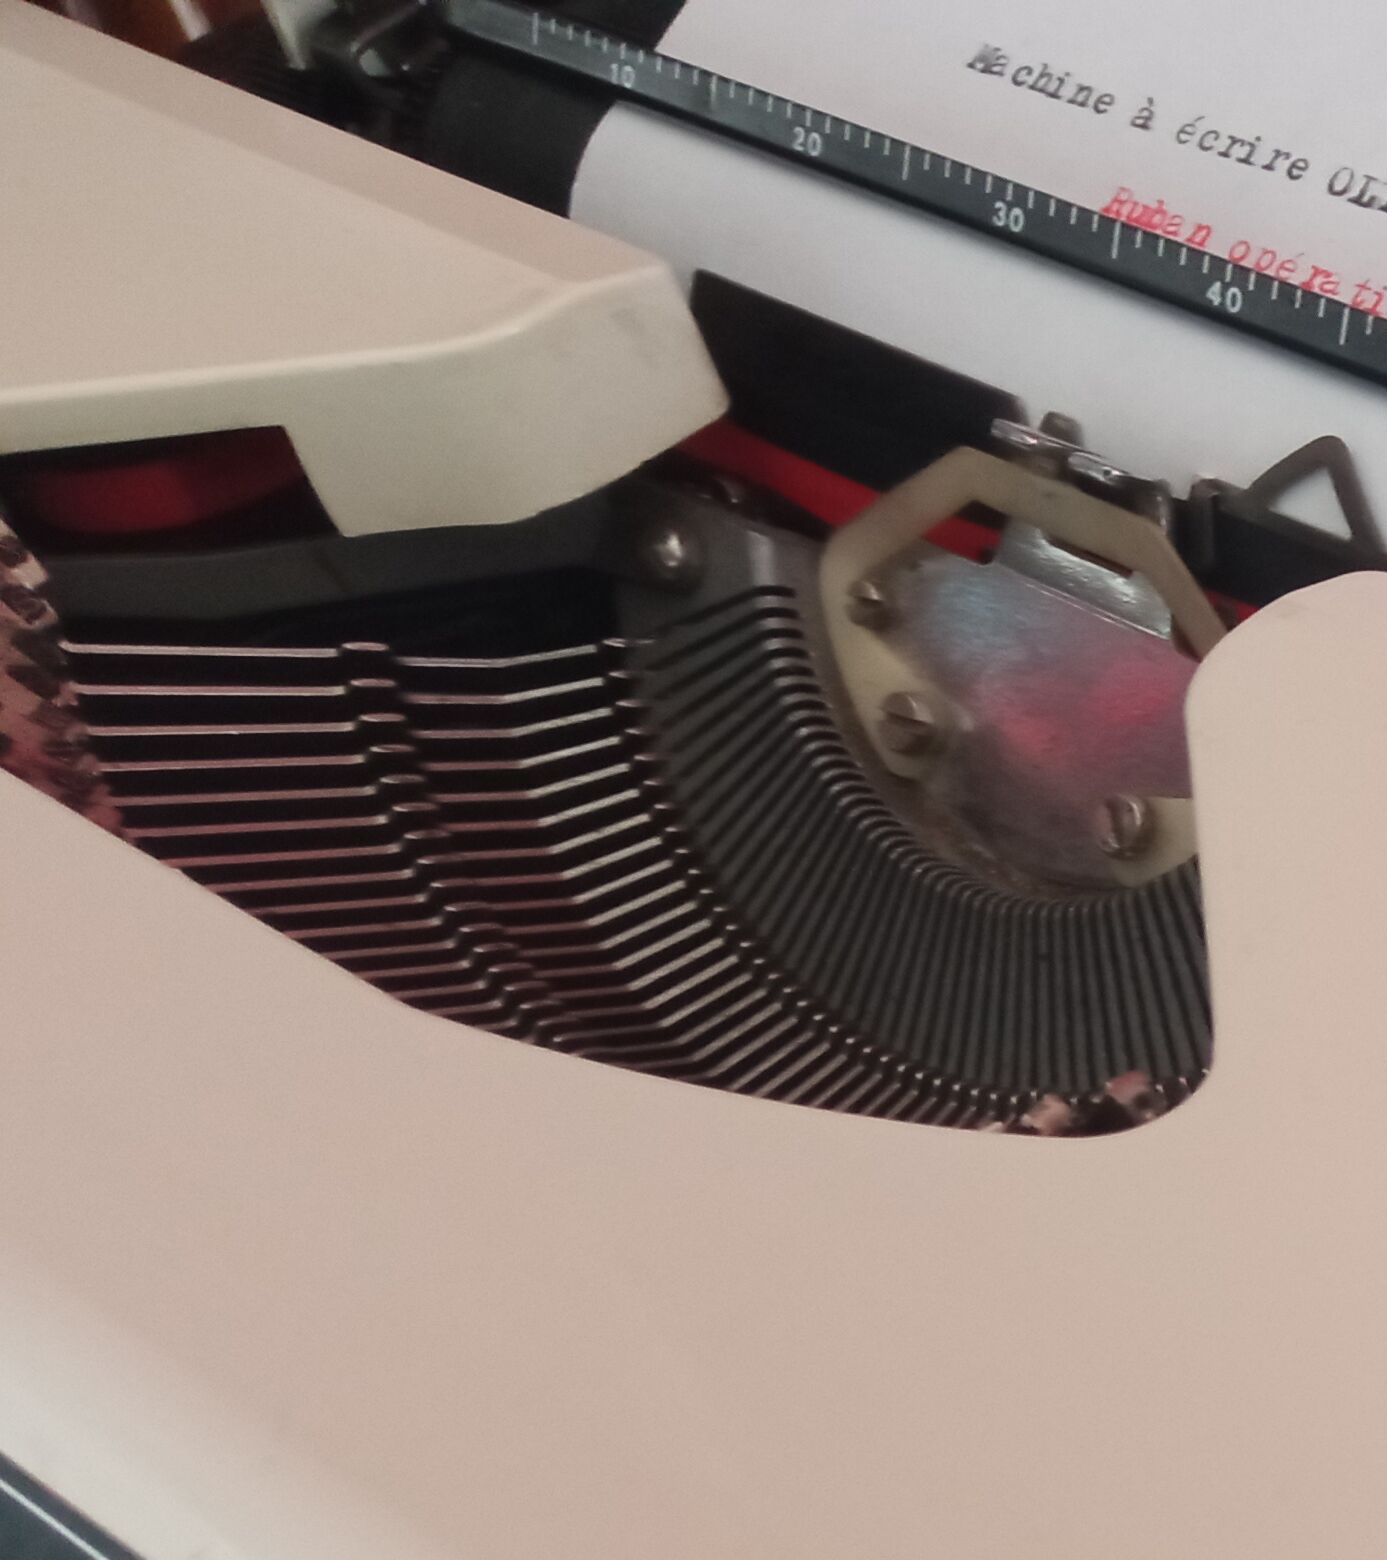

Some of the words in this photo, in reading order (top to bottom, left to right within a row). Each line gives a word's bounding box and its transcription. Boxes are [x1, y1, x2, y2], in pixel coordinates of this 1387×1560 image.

[966, 43, 1115, 115] Machine
[1130, 96, 1156, 130] à
[1176, 115, 1310, 180] écrire
[607, 63, 636, 90] 10
[792, 126, 823, 158] 20
[992, 201, 1025, 234] 30
[1206, 279, 1243, 314] 40
[1098, 186, 1214, 248] Ruban
